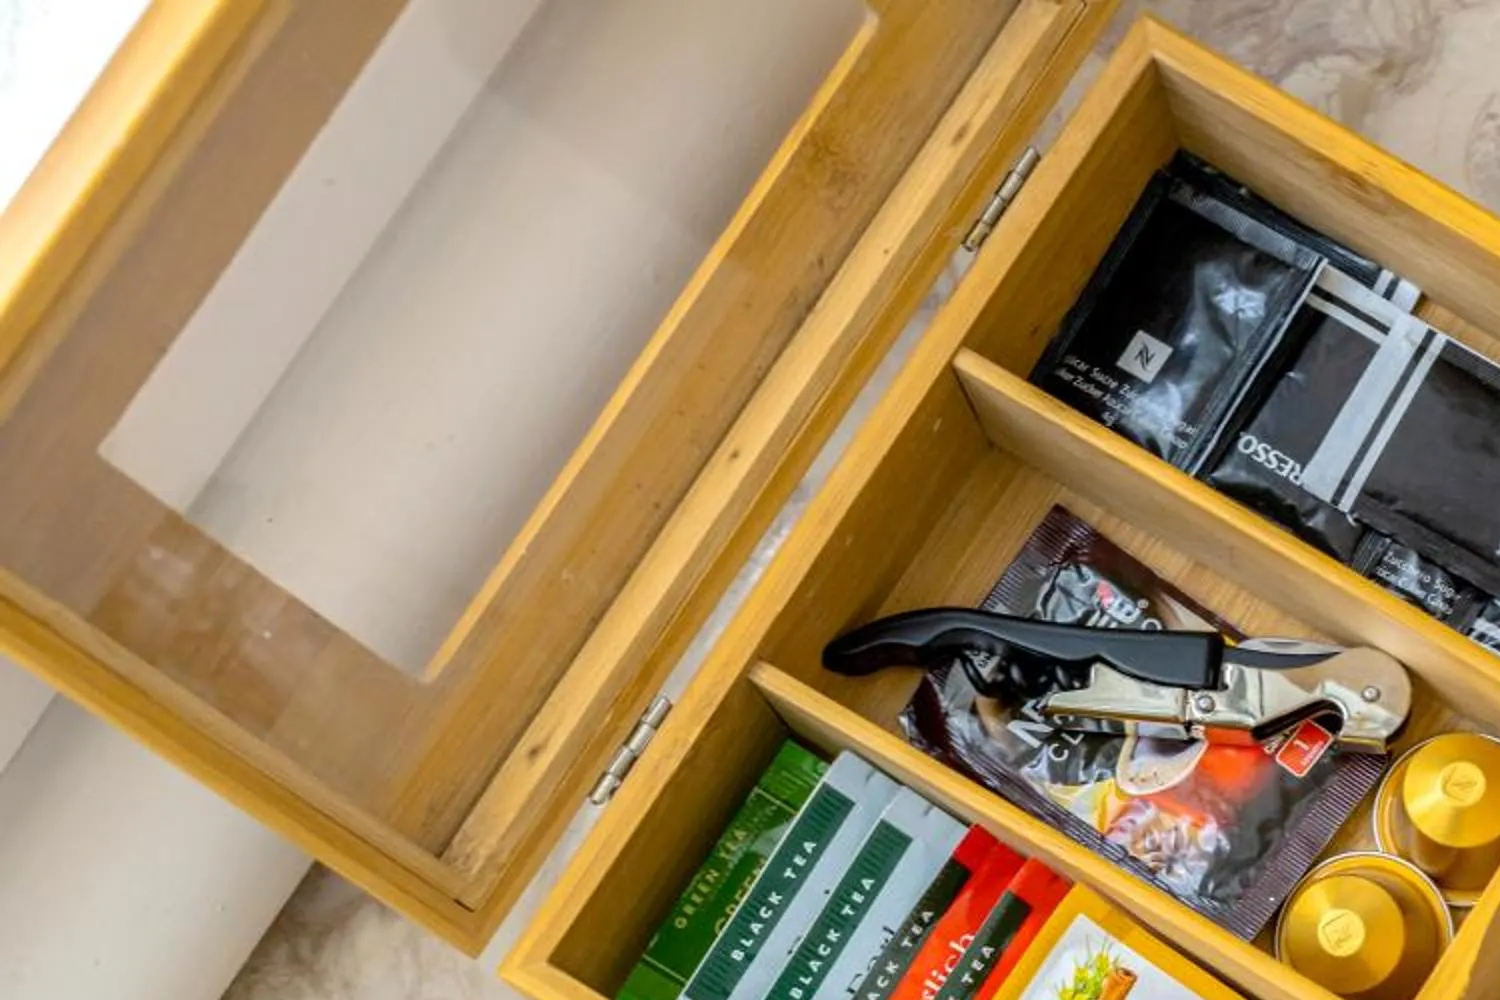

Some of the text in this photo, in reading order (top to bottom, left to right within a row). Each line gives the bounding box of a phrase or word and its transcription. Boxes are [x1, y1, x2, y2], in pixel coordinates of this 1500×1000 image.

[731, 890, 784, 963] BLACK
[784, 839, 817, 880] TEA
[789, 928, 841, 1000] BLACK
[840, 877, 875, 917] TEA
[900, 910, 935, 950] TEA
[960, 945, 996, 986] TEA
